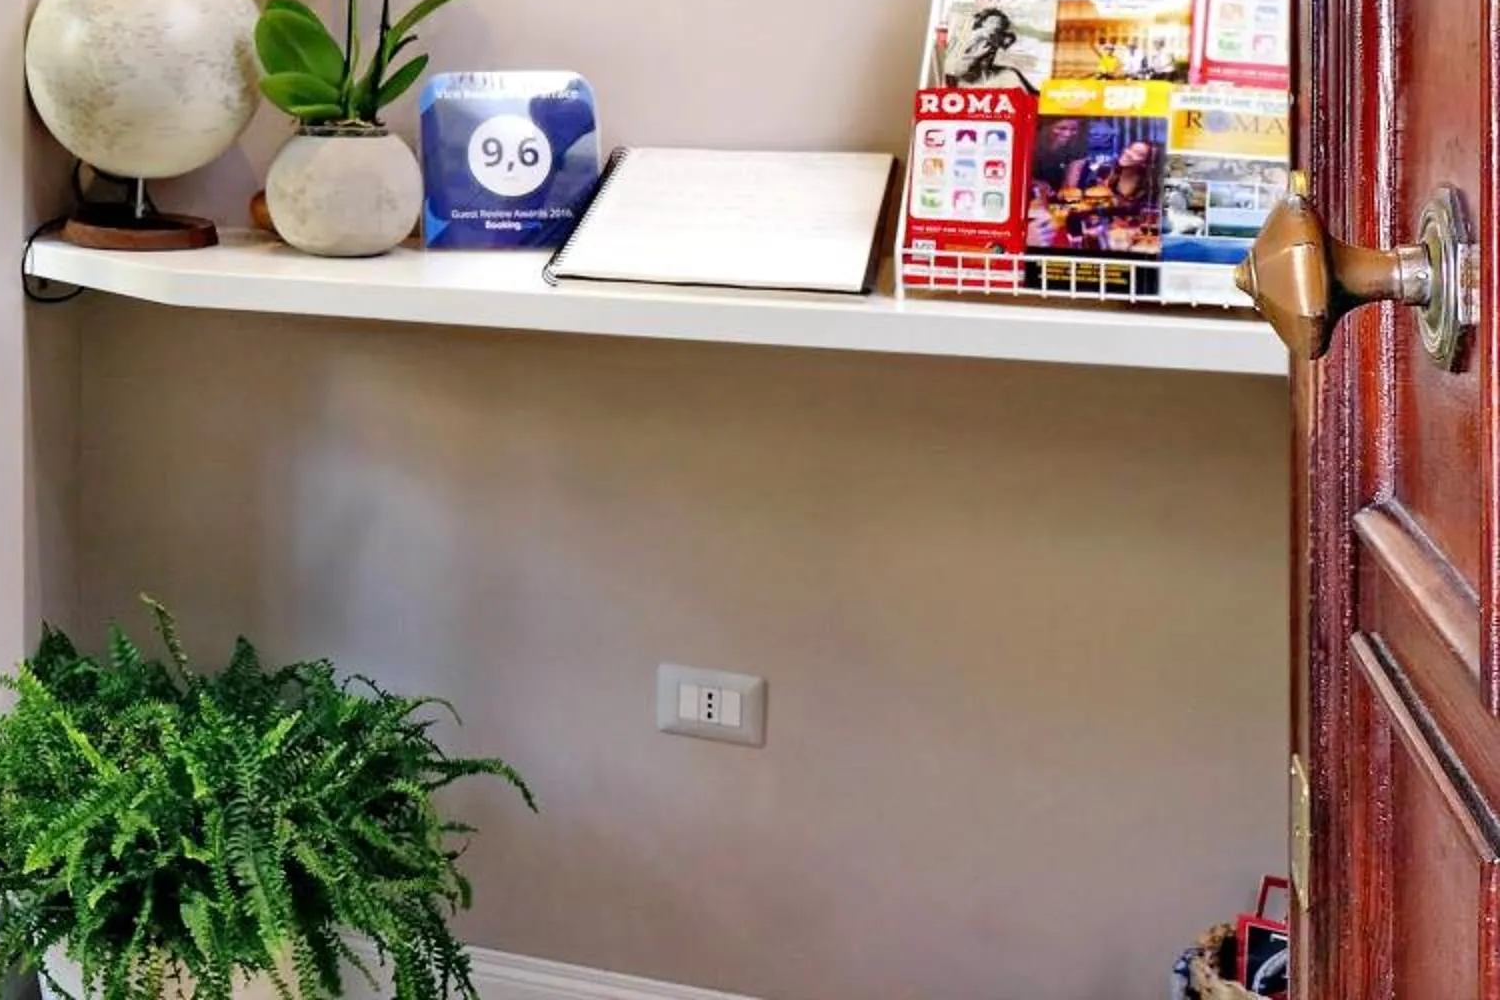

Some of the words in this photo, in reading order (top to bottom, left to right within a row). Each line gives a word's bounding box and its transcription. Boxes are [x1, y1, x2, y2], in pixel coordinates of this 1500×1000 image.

[920, 93, 1016, 113] ROMA
[481, 137, 540, 172] 9,6
[451, 208, 478, 220] Guest
[480, 208, 512, 219] Review
[513, 208, 548, 219] Awards
